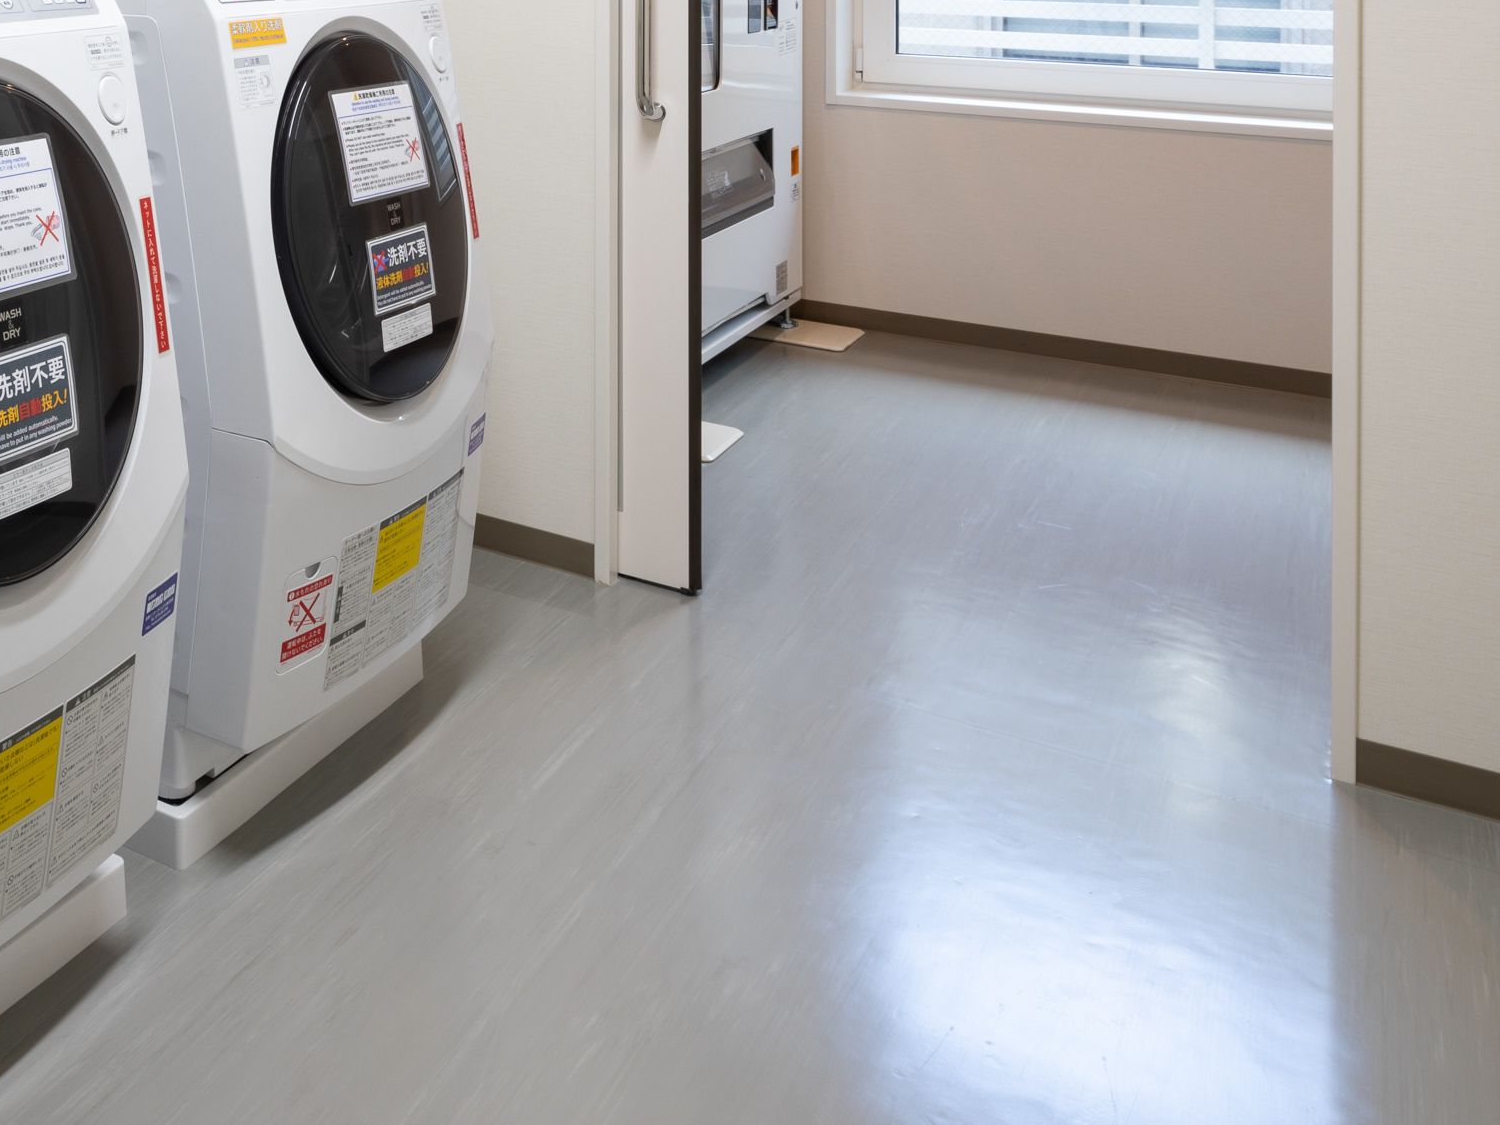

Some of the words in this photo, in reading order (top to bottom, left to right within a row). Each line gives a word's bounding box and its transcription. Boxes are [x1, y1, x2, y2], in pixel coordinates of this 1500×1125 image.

[387, 239, 427, 267] 洗剤不要
[3, 328, 21, 341] DRY
